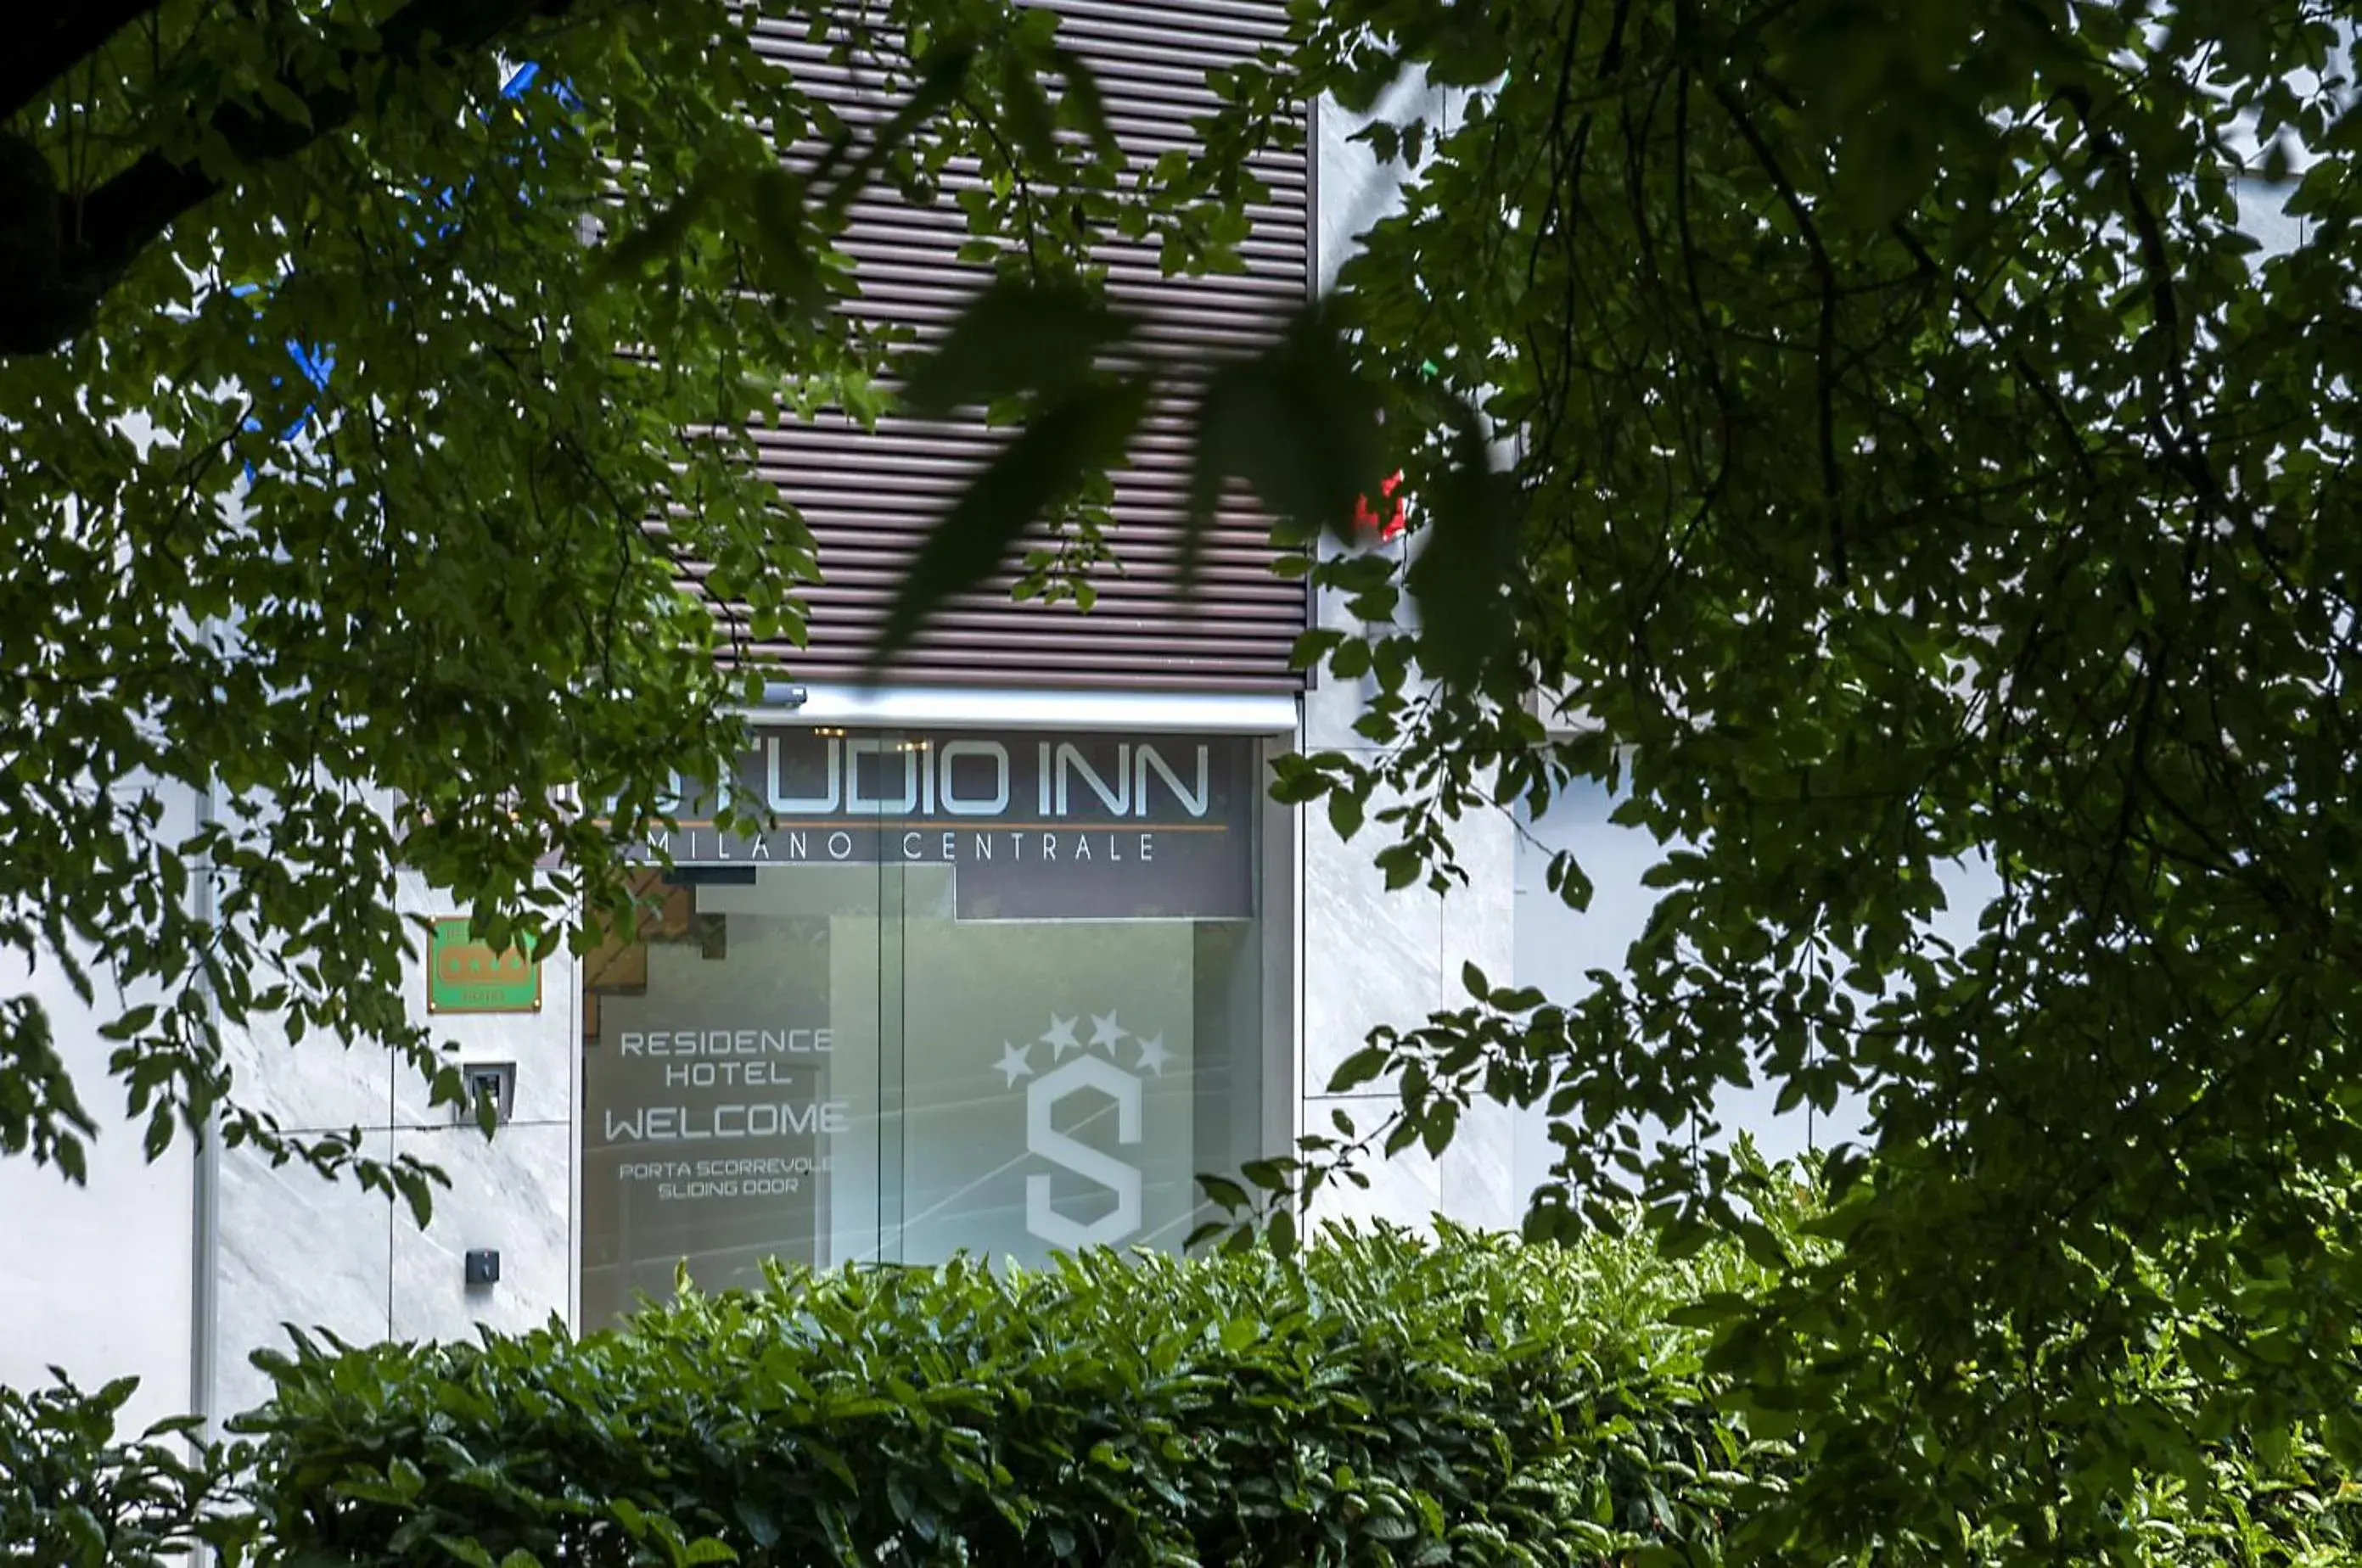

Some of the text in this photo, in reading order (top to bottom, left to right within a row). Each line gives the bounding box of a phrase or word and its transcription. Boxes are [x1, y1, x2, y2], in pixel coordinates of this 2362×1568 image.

[1037, 741, 1209, 817] INN
[647, 830, 1153, 862] MILANO CENTRALE
[620, 1028, 836, 1057] RESIDENCE
[665, 1061, 793, 1088] HOTEL
[604, 1102, 850, 1141] WELCOME
[620, 1162, 692, 1180] PORTA
[658, 1177, 799, 1201] SLIDING DOOR
